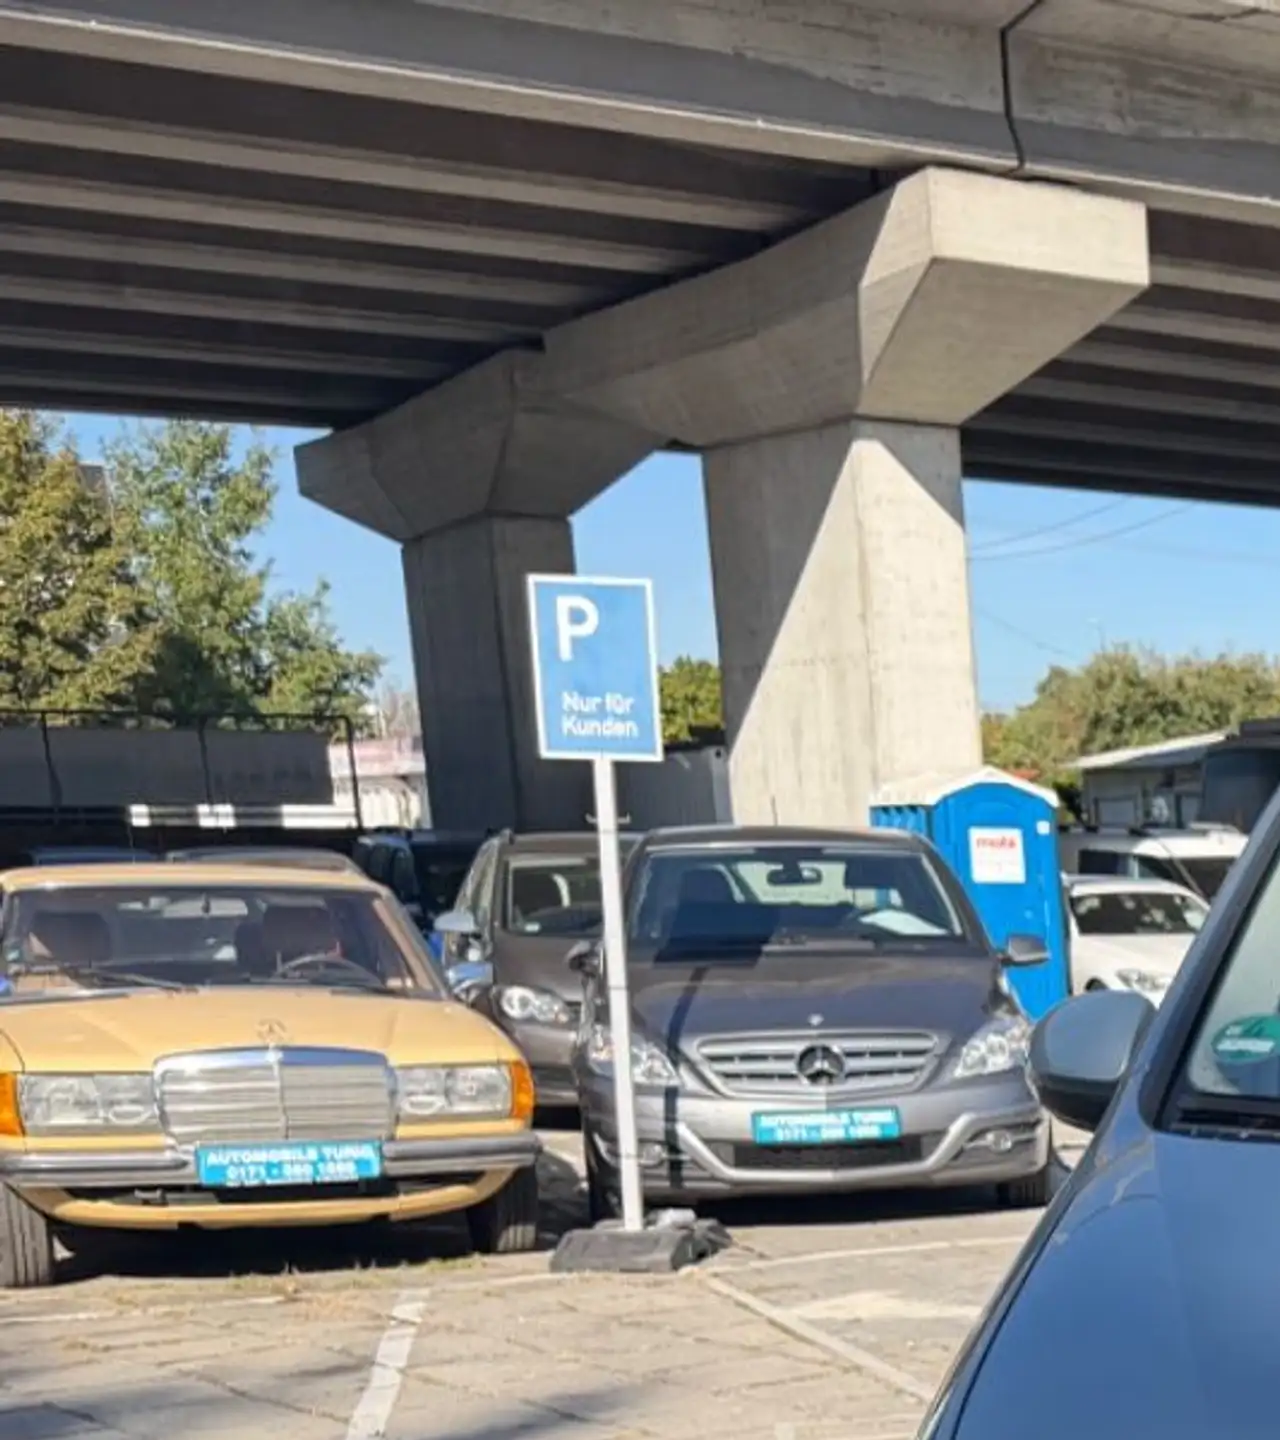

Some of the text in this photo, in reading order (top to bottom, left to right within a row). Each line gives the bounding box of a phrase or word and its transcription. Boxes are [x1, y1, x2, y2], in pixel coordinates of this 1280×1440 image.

[557, 595, 599, 662] P
[562, 691, 635, 714] Nur für
[562, 715, 639, 738] Kunden
